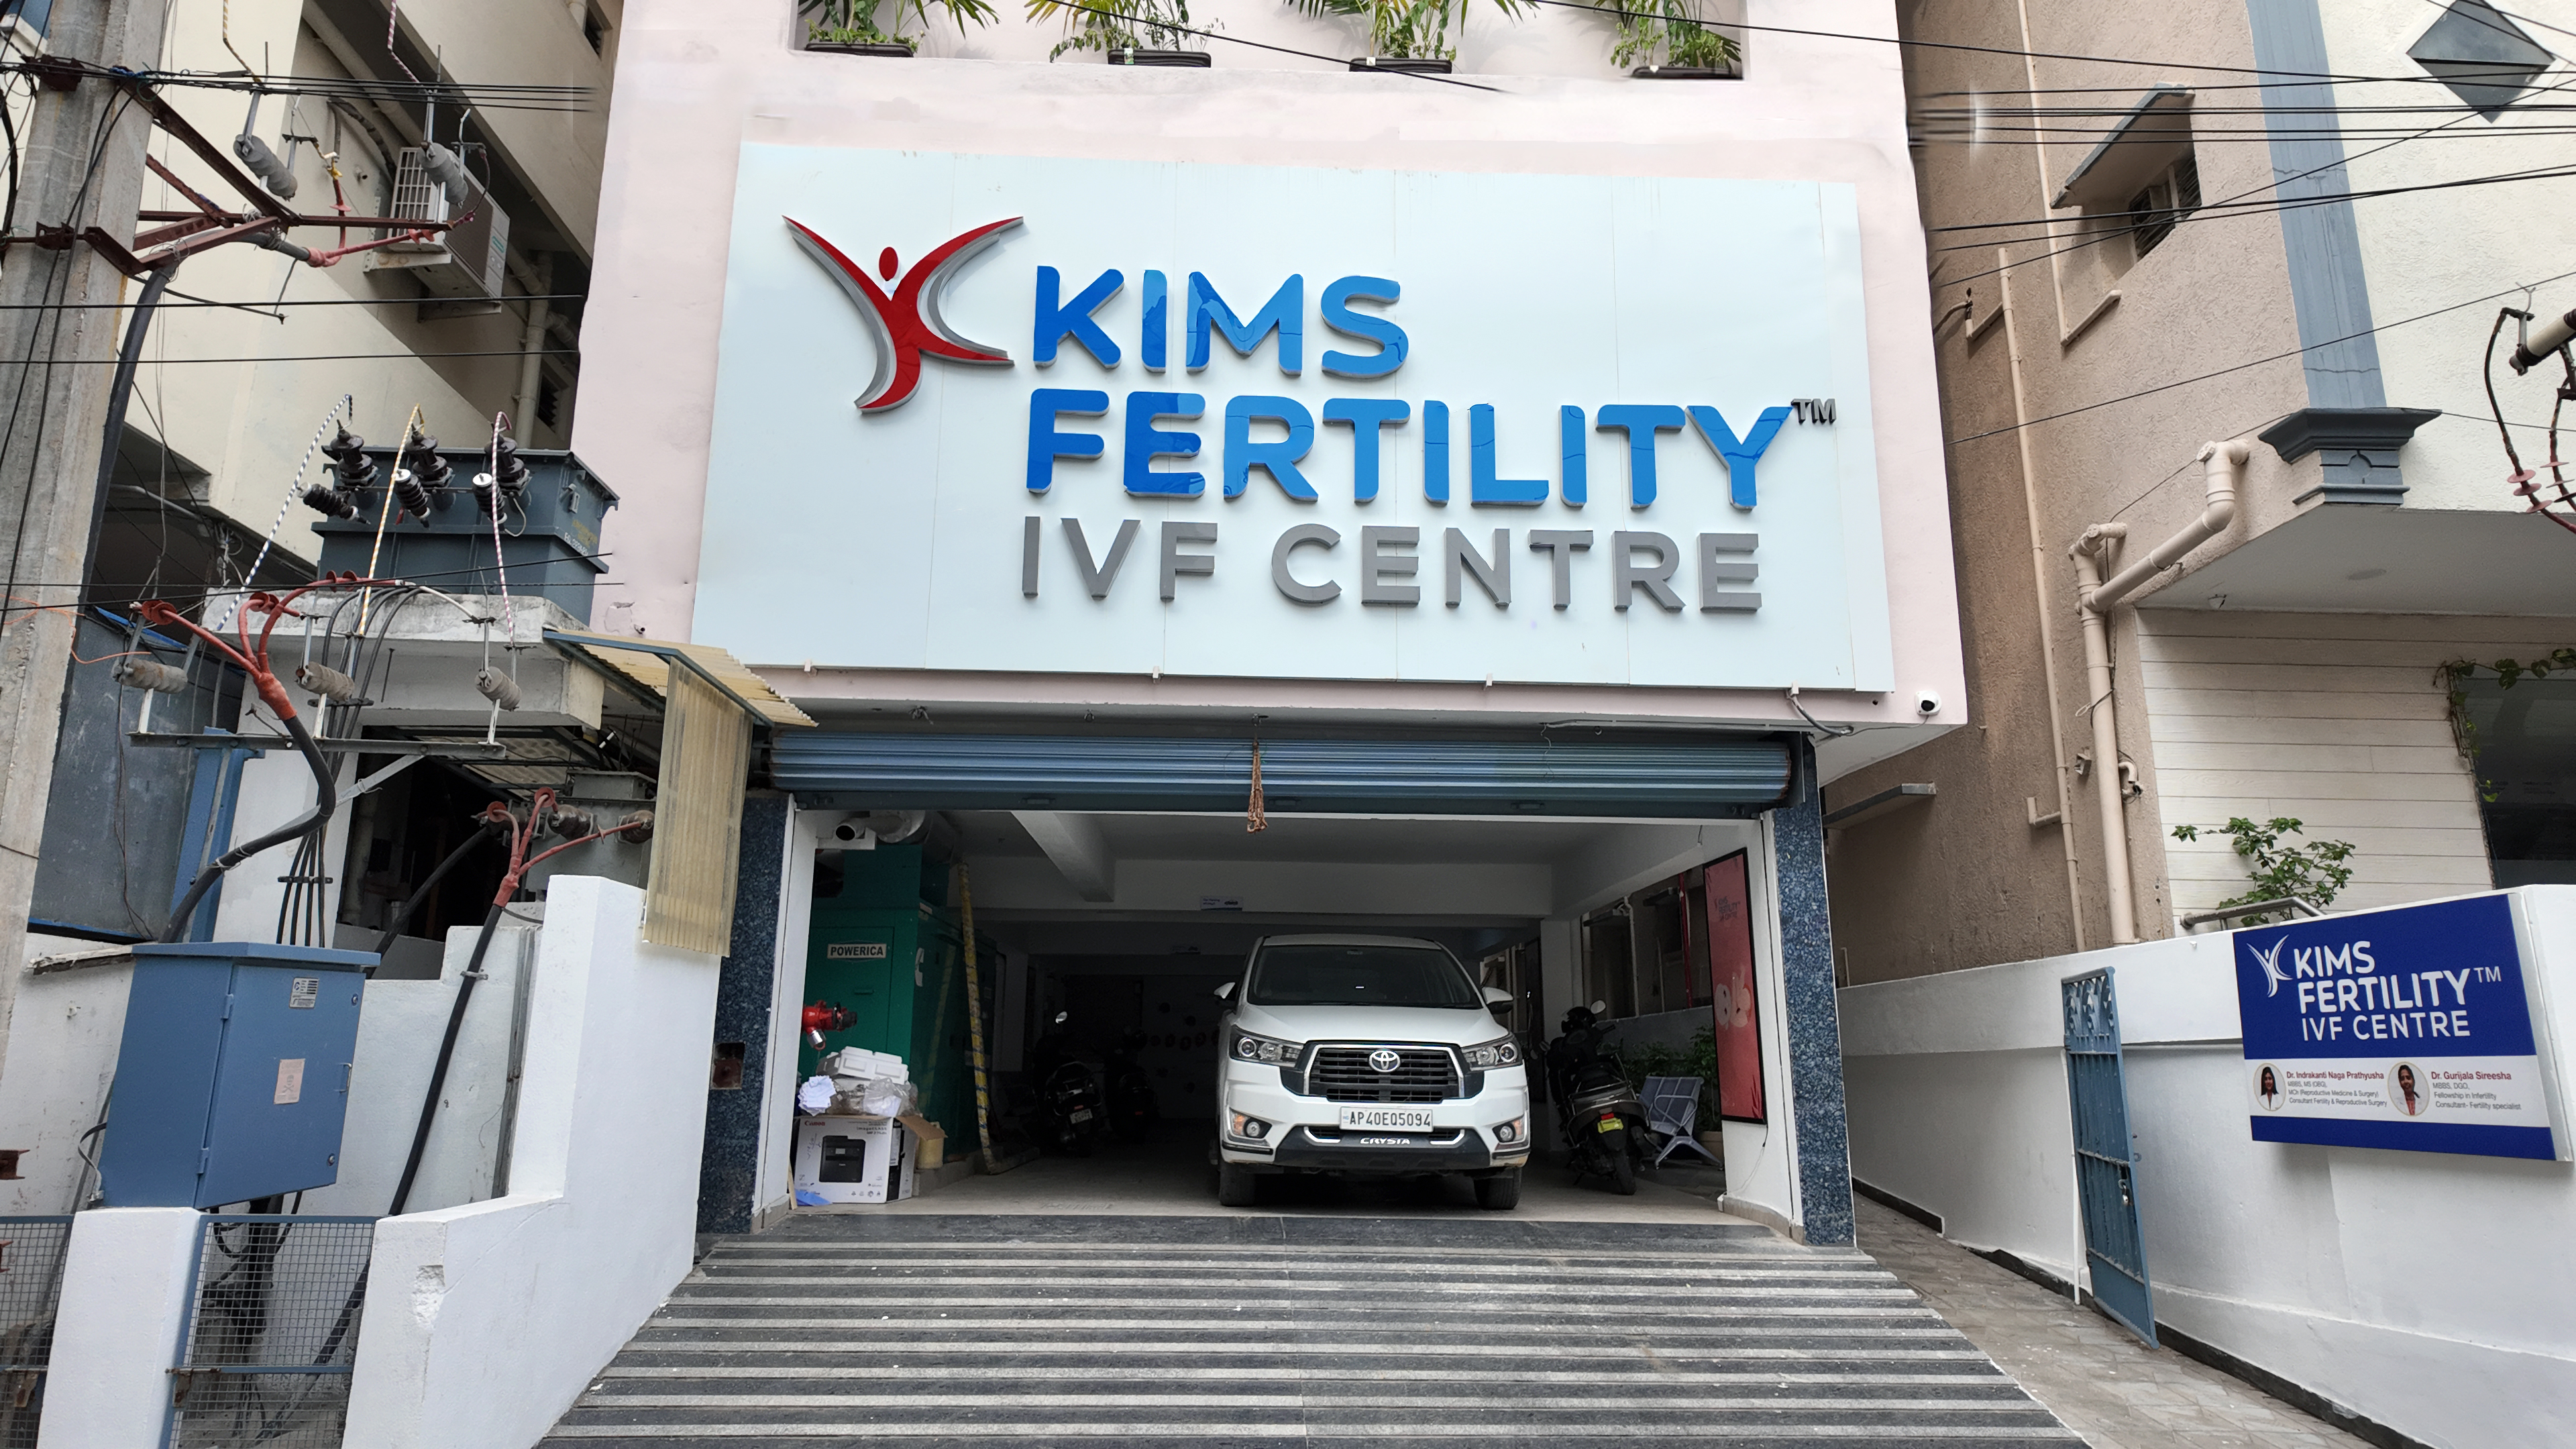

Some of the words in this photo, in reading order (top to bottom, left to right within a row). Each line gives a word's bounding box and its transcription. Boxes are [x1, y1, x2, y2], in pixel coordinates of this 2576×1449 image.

[1033, 266, 1409, 378] KIMS
[1026, 388, 1792, 511] FERTILITY
[1790, 398, 1837, 424] TM
[1022, 516, 1218, 602] IVF
[1271, 523, 1762, 612] CENTRE
[830, 947, 883, 956] POWERICA
[2294, 941, 2375, 979] KIMS
[2298, 968, 2471, 1014] FERTILITY
[2473, 966, 2502, 983] TM
[2302, 1016, 2343, 1041] IVF
[2353, 1010, 2471, 1040] CENTRE
[2328, 1071, 2345, 1081] Naga
[2347, 1071, 2384, 1081] Prathyusha
[2431, 1071, 2442, 1079] Dr.
[2444, 1071, 2474, 1081] Gurijala
[2475, 1071, 2512, 1080] Sireesha
[2434, 1091, 2464, 1099] Fellowship
[2471, 1092, 2496, 1100] Infertility
[2368, 1099, 2387, 1108] Surgery
[2469, 1102, 2491, 1110] Fertility
[1350, 1112, 1430, 1127] AP40EQ5094
